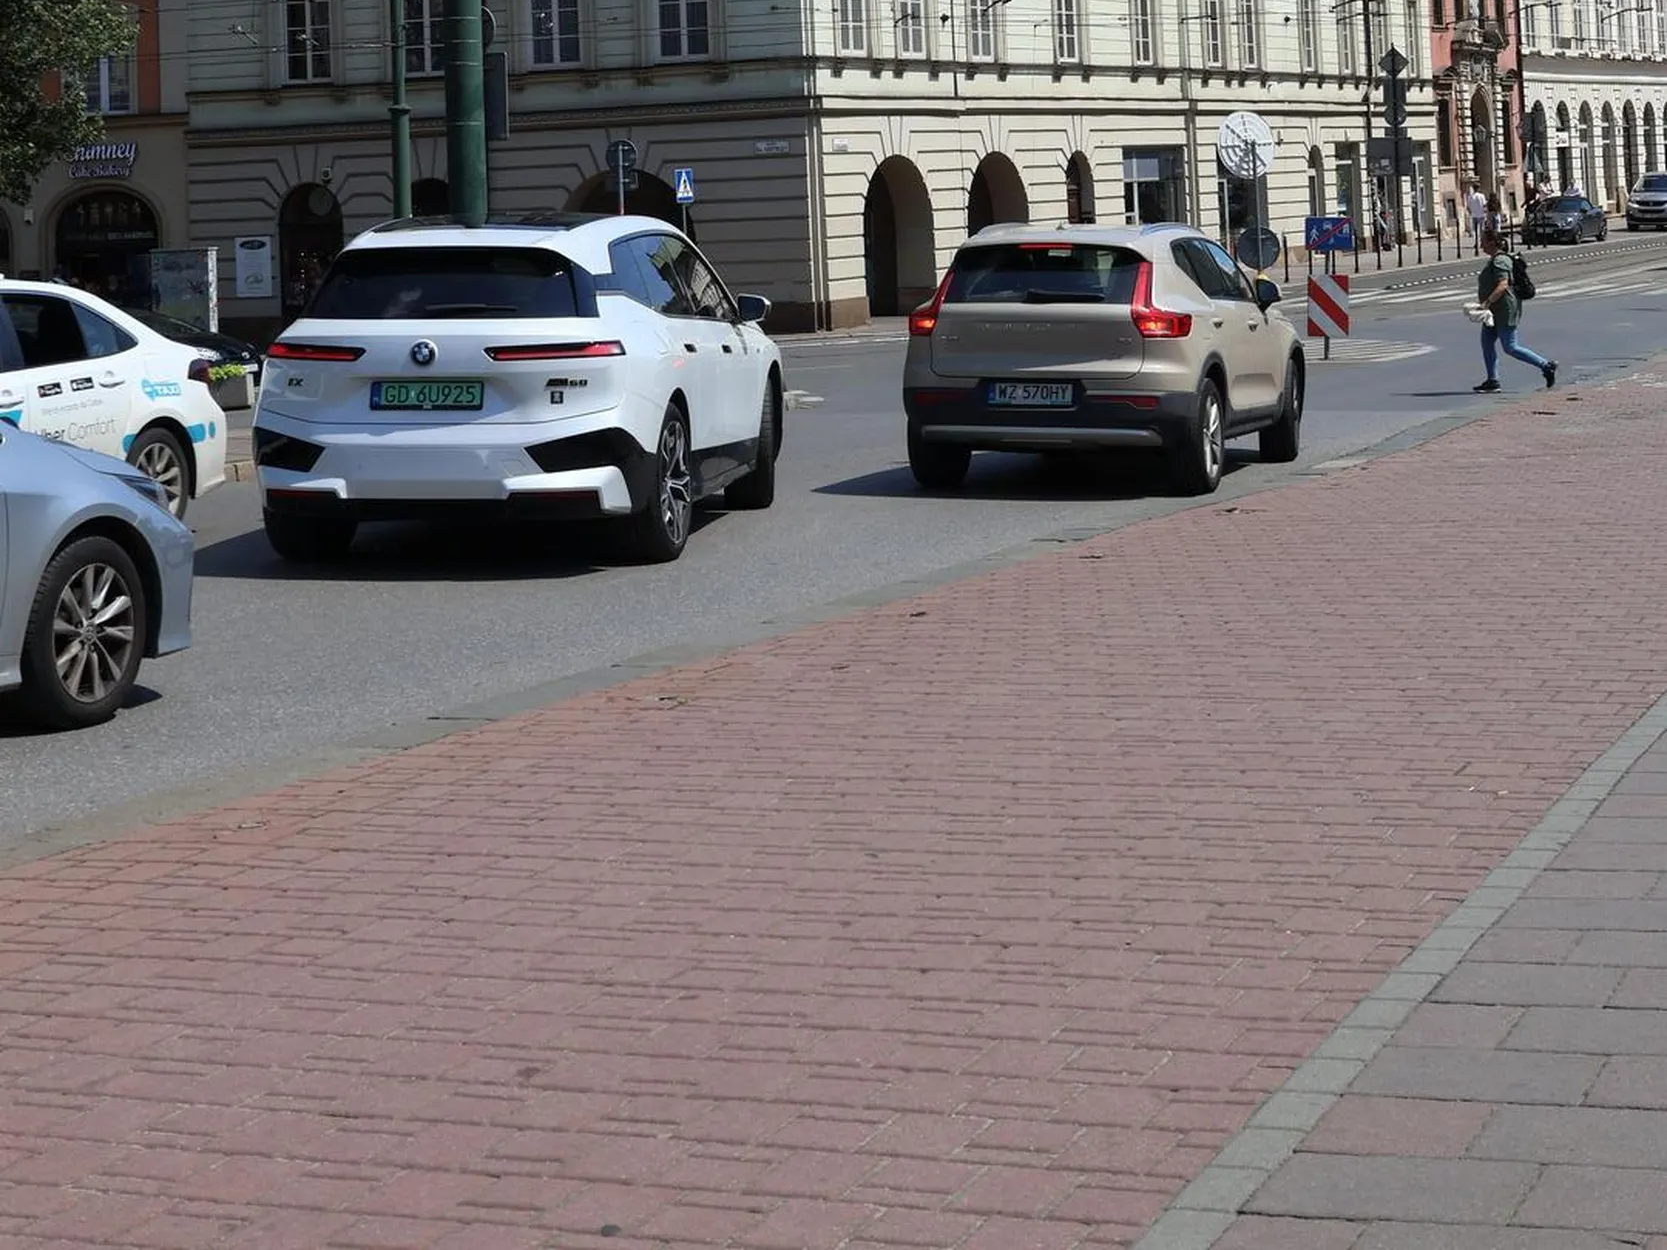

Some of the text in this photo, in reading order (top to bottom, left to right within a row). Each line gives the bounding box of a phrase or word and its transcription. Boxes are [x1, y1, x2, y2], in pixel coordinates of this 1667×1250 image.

[384, 384, 477, 404] GD 6U925
[998, 384, 1069, 400] WZ 570HY
[68, 419, 116, 442] Comfort
